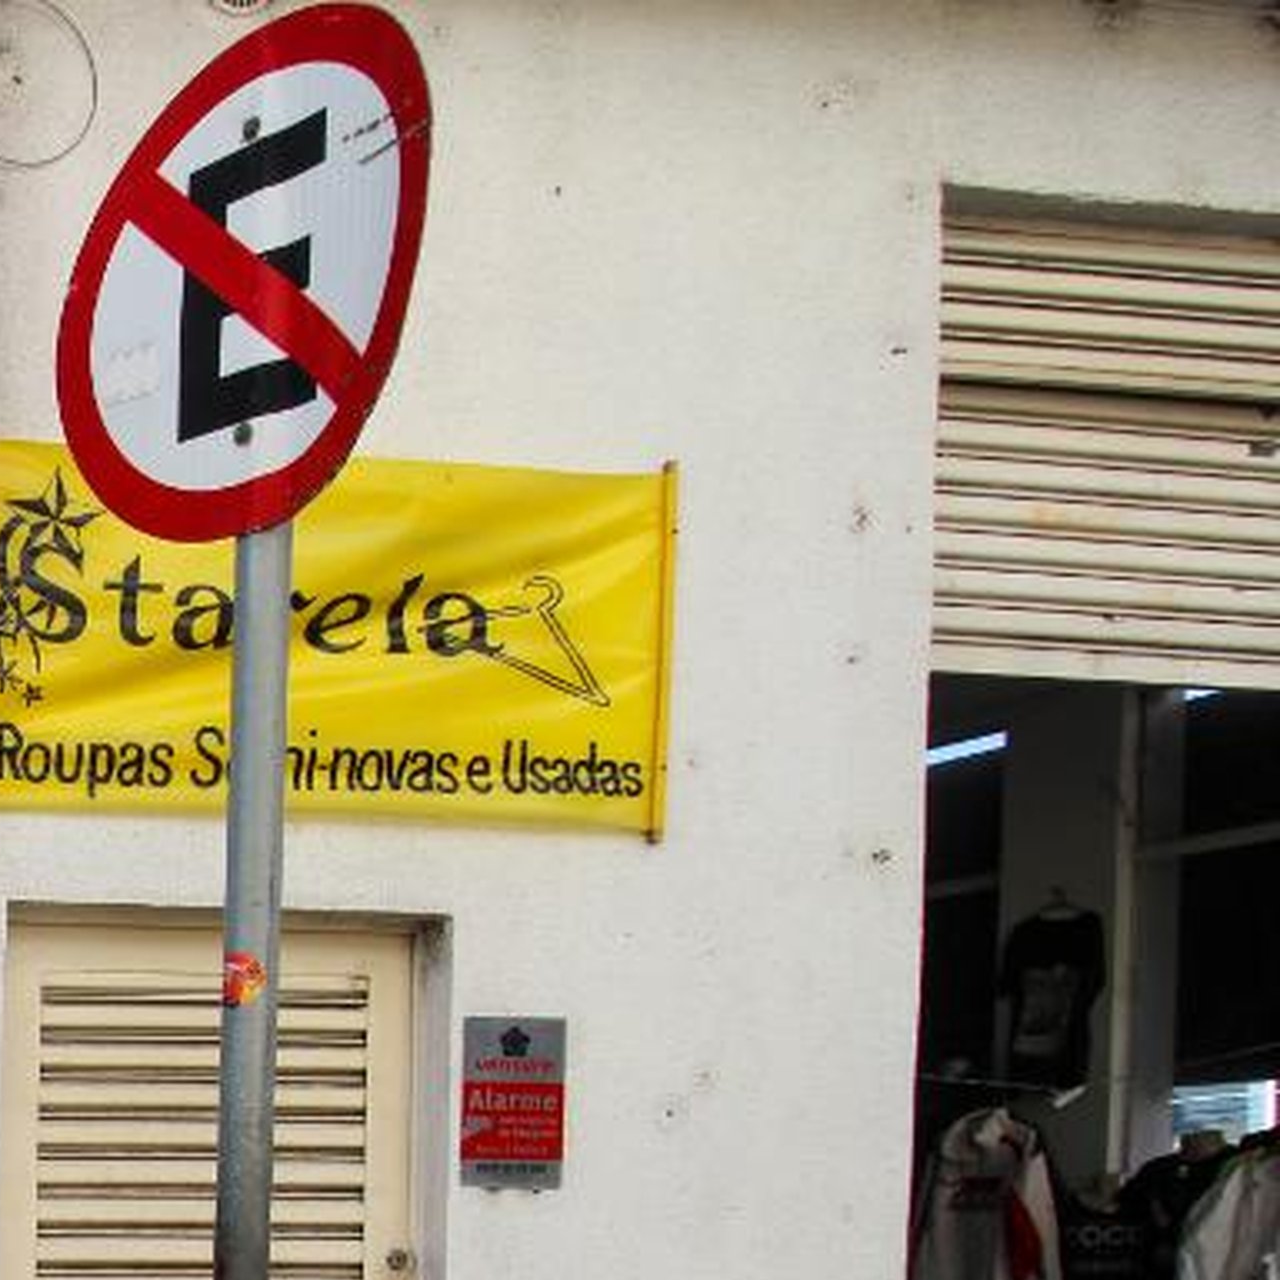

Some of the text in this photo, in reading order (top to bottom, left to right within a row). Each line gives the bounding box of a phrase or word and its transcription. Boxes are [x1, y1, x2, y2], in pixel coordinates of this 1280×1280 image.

[178, 107, 327, 443] E
[466, 763, 493, 790] e
[501, 740, 644, 798] Usadas
